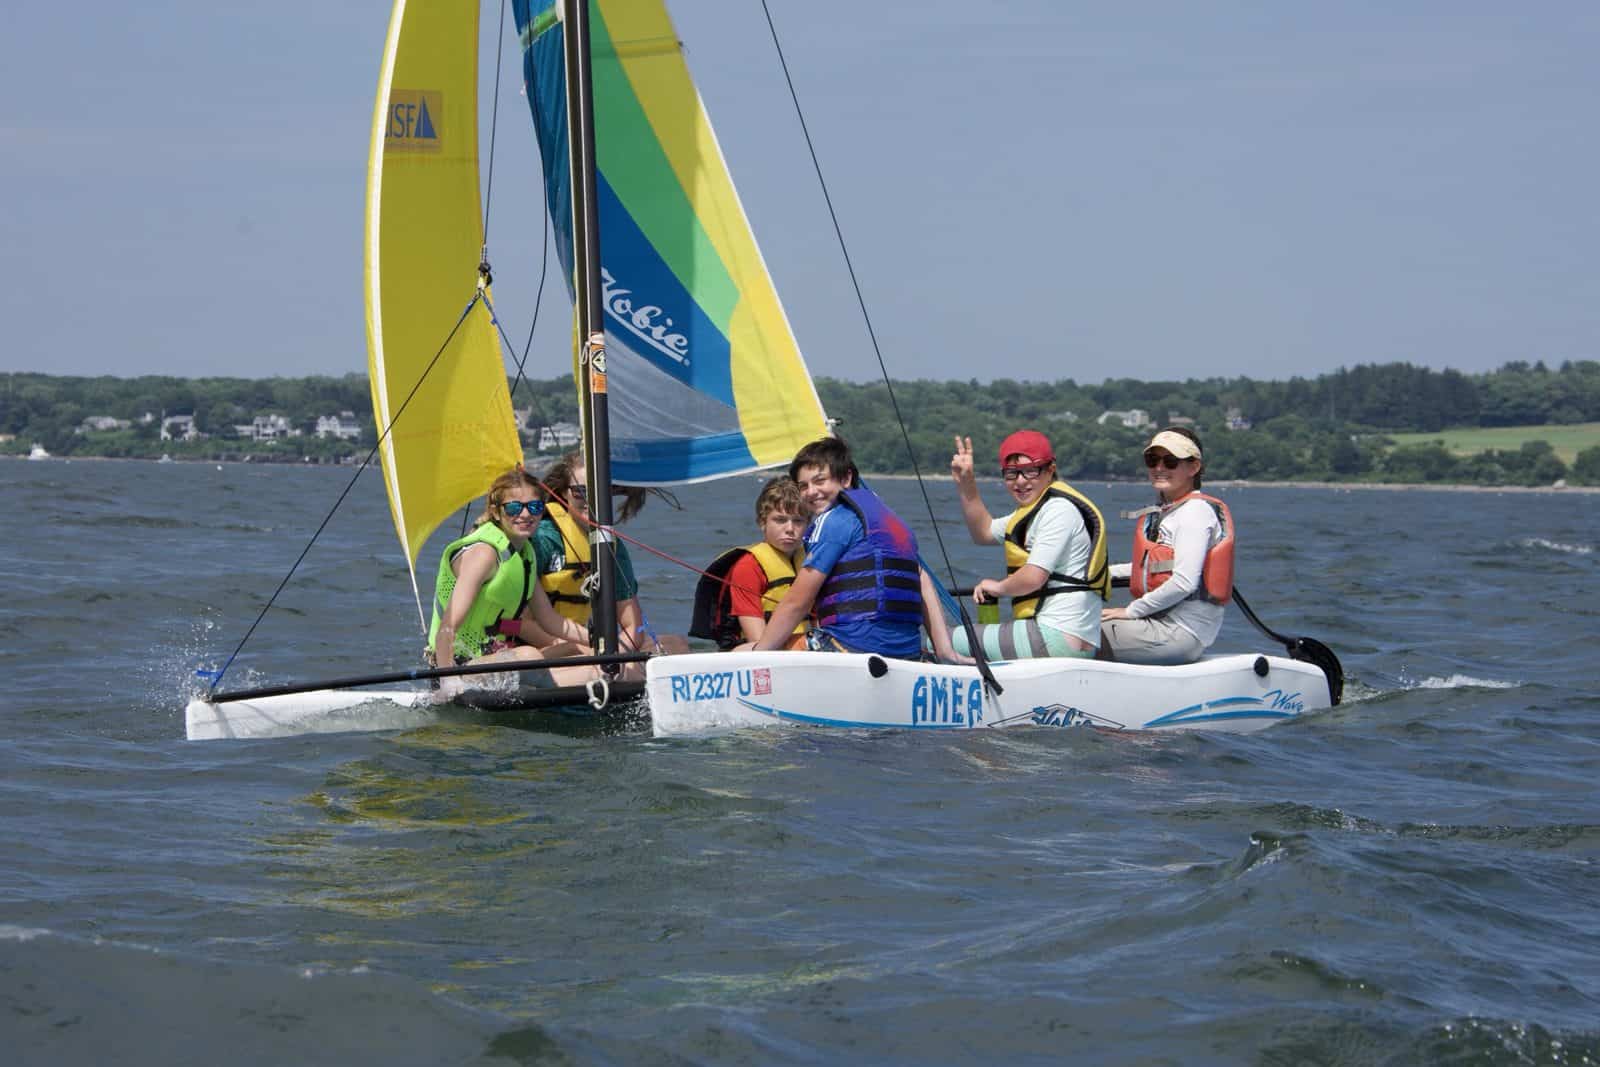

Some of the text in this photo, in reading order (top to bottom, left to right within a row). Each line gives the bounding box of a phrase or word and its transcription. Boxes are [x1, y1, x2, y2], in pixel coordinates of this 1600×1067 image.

[385, 103, 416, 138] ISF
[671, 675, 691, 702] RI
[692, 672, 734, 701] 2327
[736, 670, 751, 697] U
[912, 676, 983, 728] AMEA
